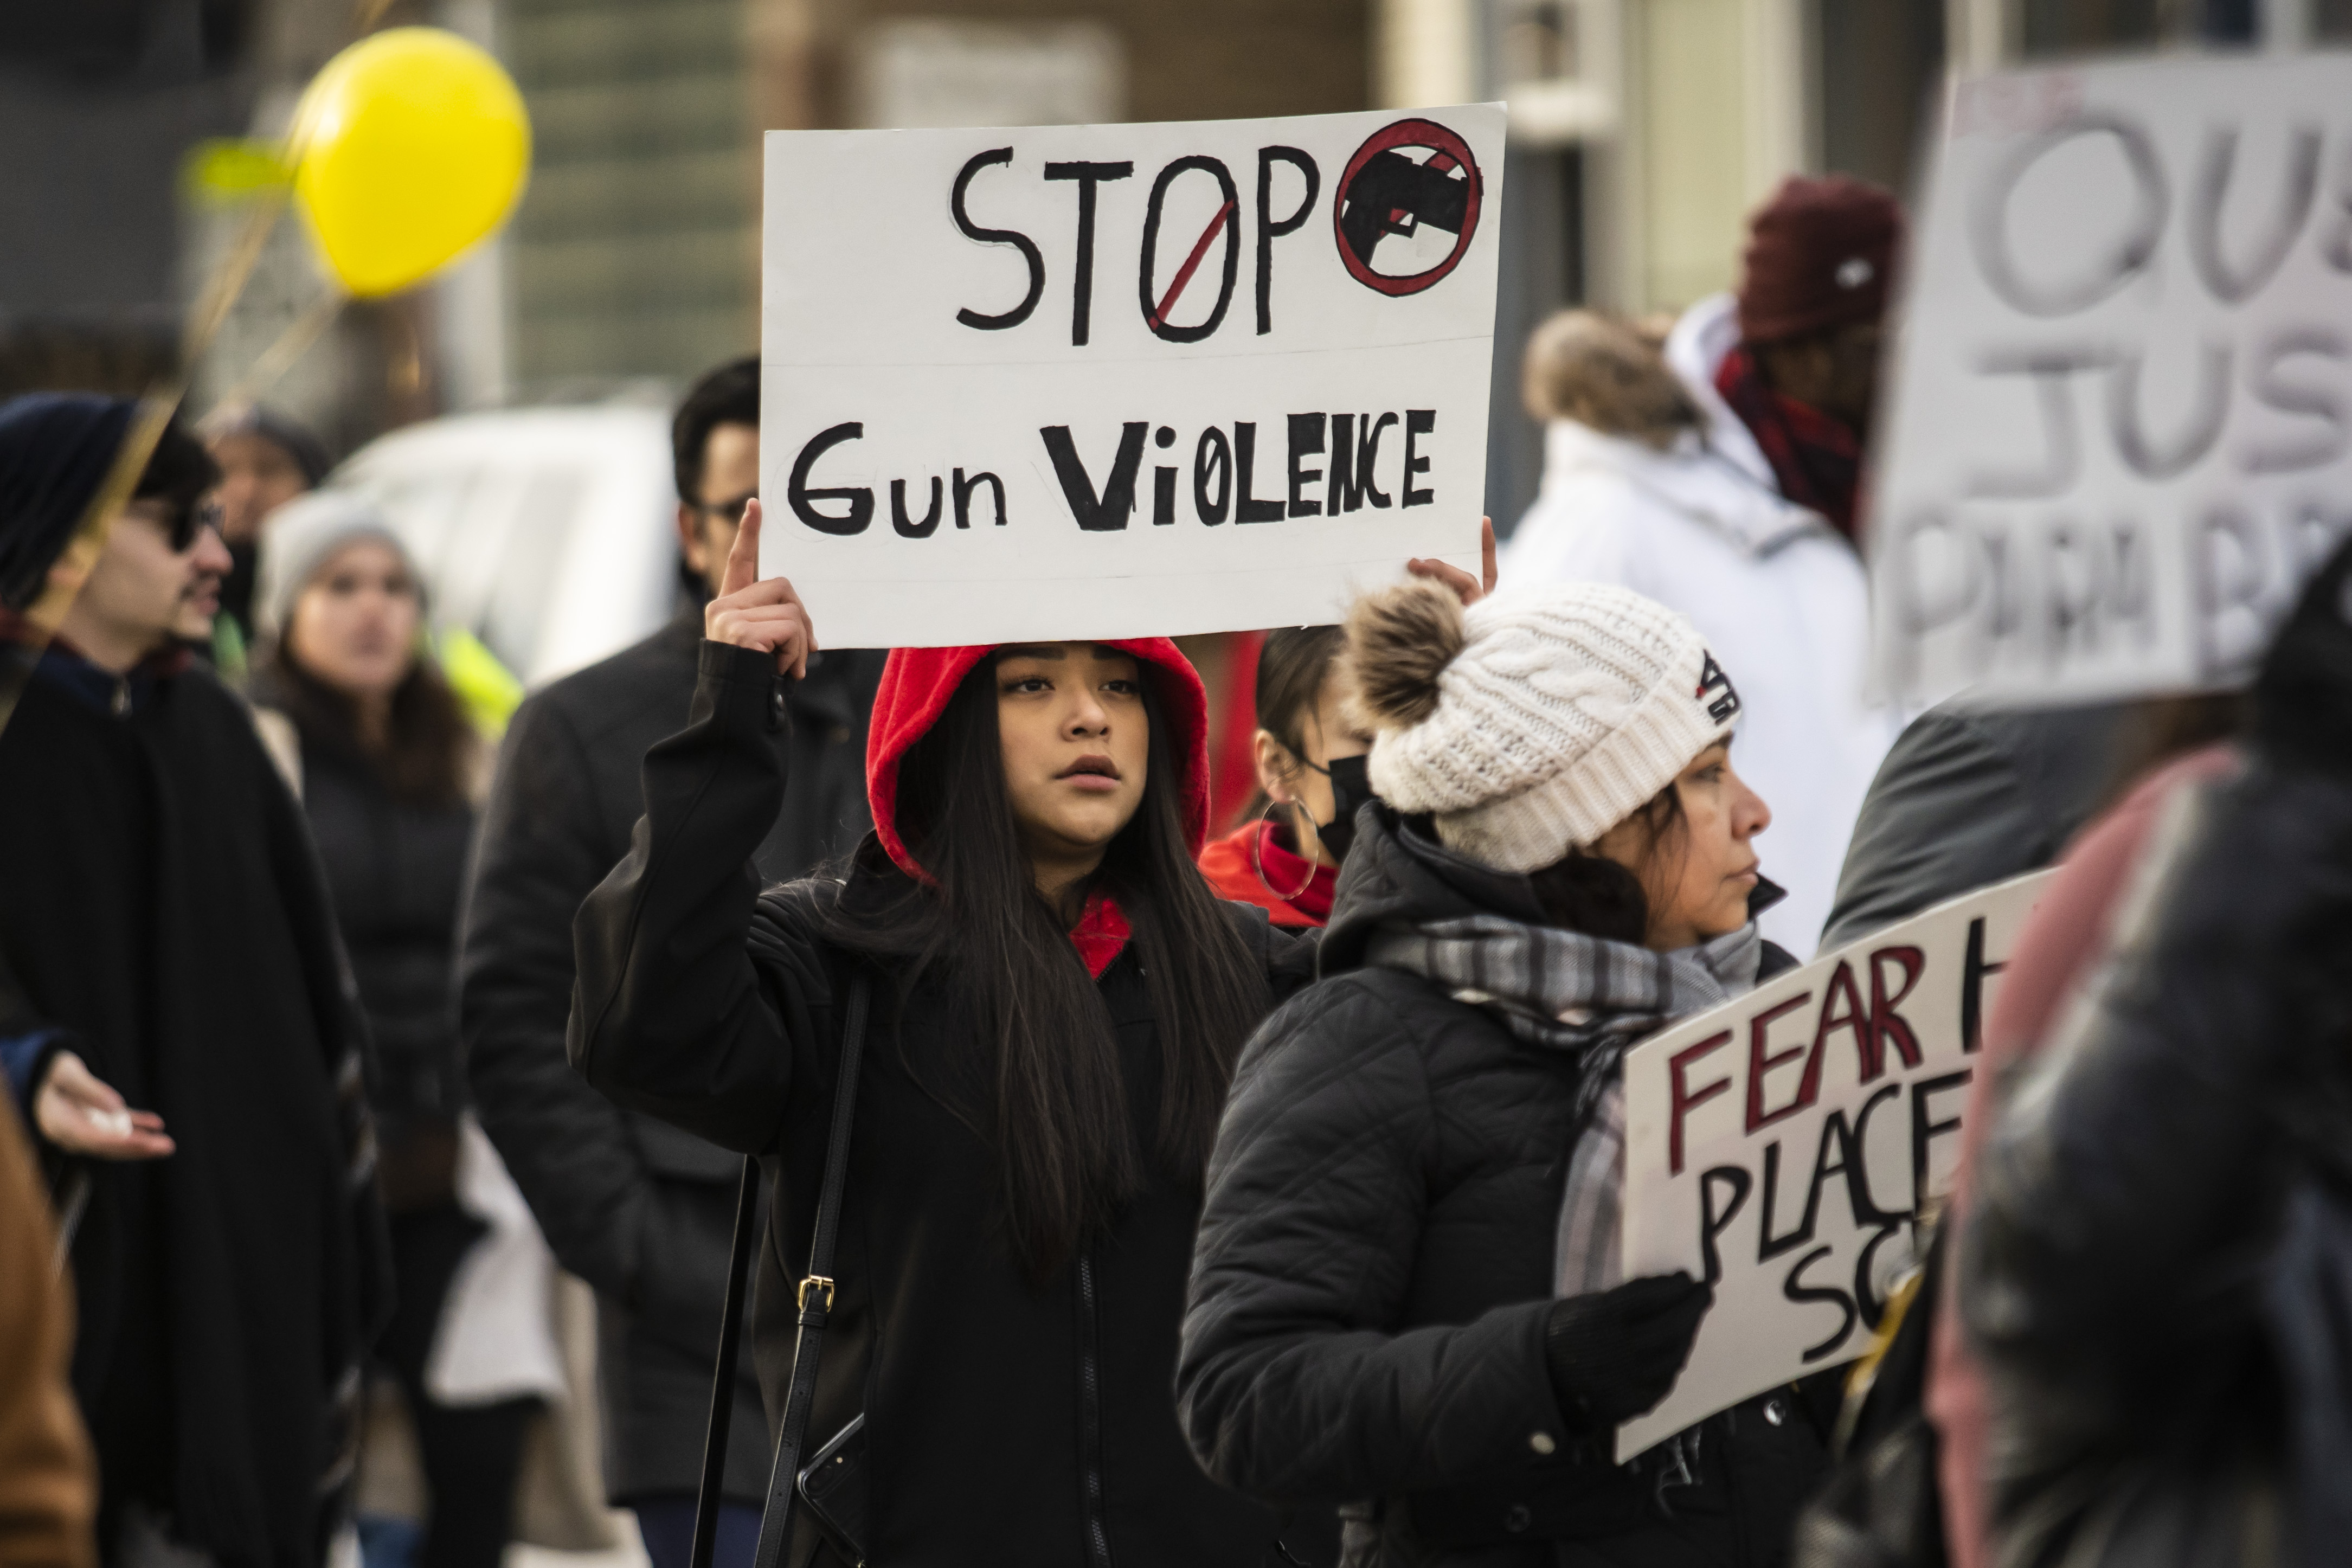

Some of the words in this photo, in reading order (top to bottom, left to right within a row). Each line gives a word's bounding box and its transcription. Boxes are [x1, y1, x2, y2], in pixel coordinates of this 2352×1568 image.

[950, 145, 1321, 347] STOP
[787, 421, 1008, 539] Gun
[1668, 945, 1925, 1178] FEAR
